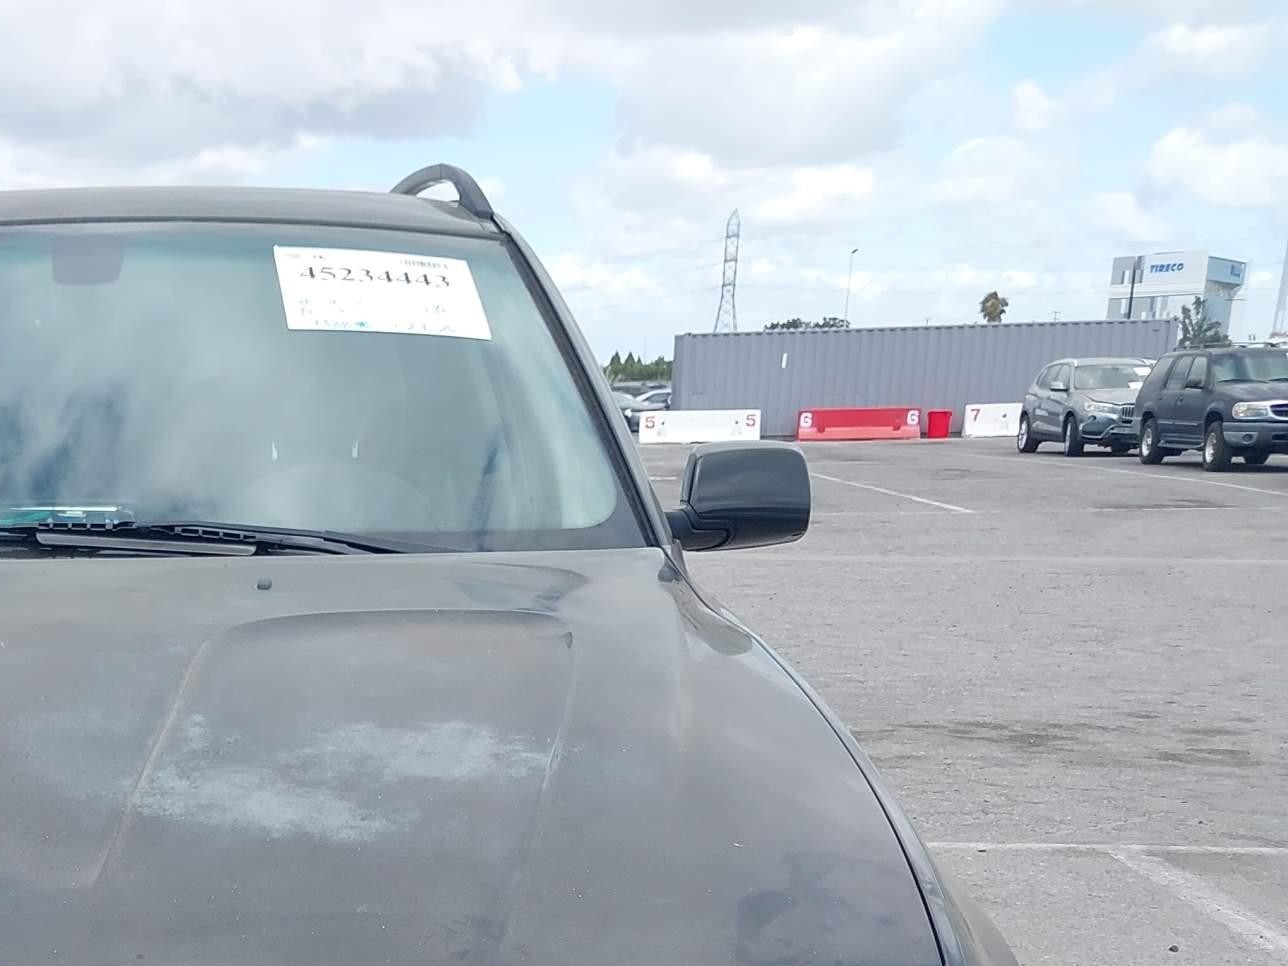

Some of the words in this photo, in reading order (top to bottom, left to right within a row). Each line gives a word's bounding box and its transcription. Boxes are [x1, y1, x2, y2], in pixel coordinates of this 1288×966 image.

[300, 266, 450, 288] 45234443
[746, 414, 757, 427] 5
[970, 409, 980, 421] 7
[645, 416, 655, 429] 5
